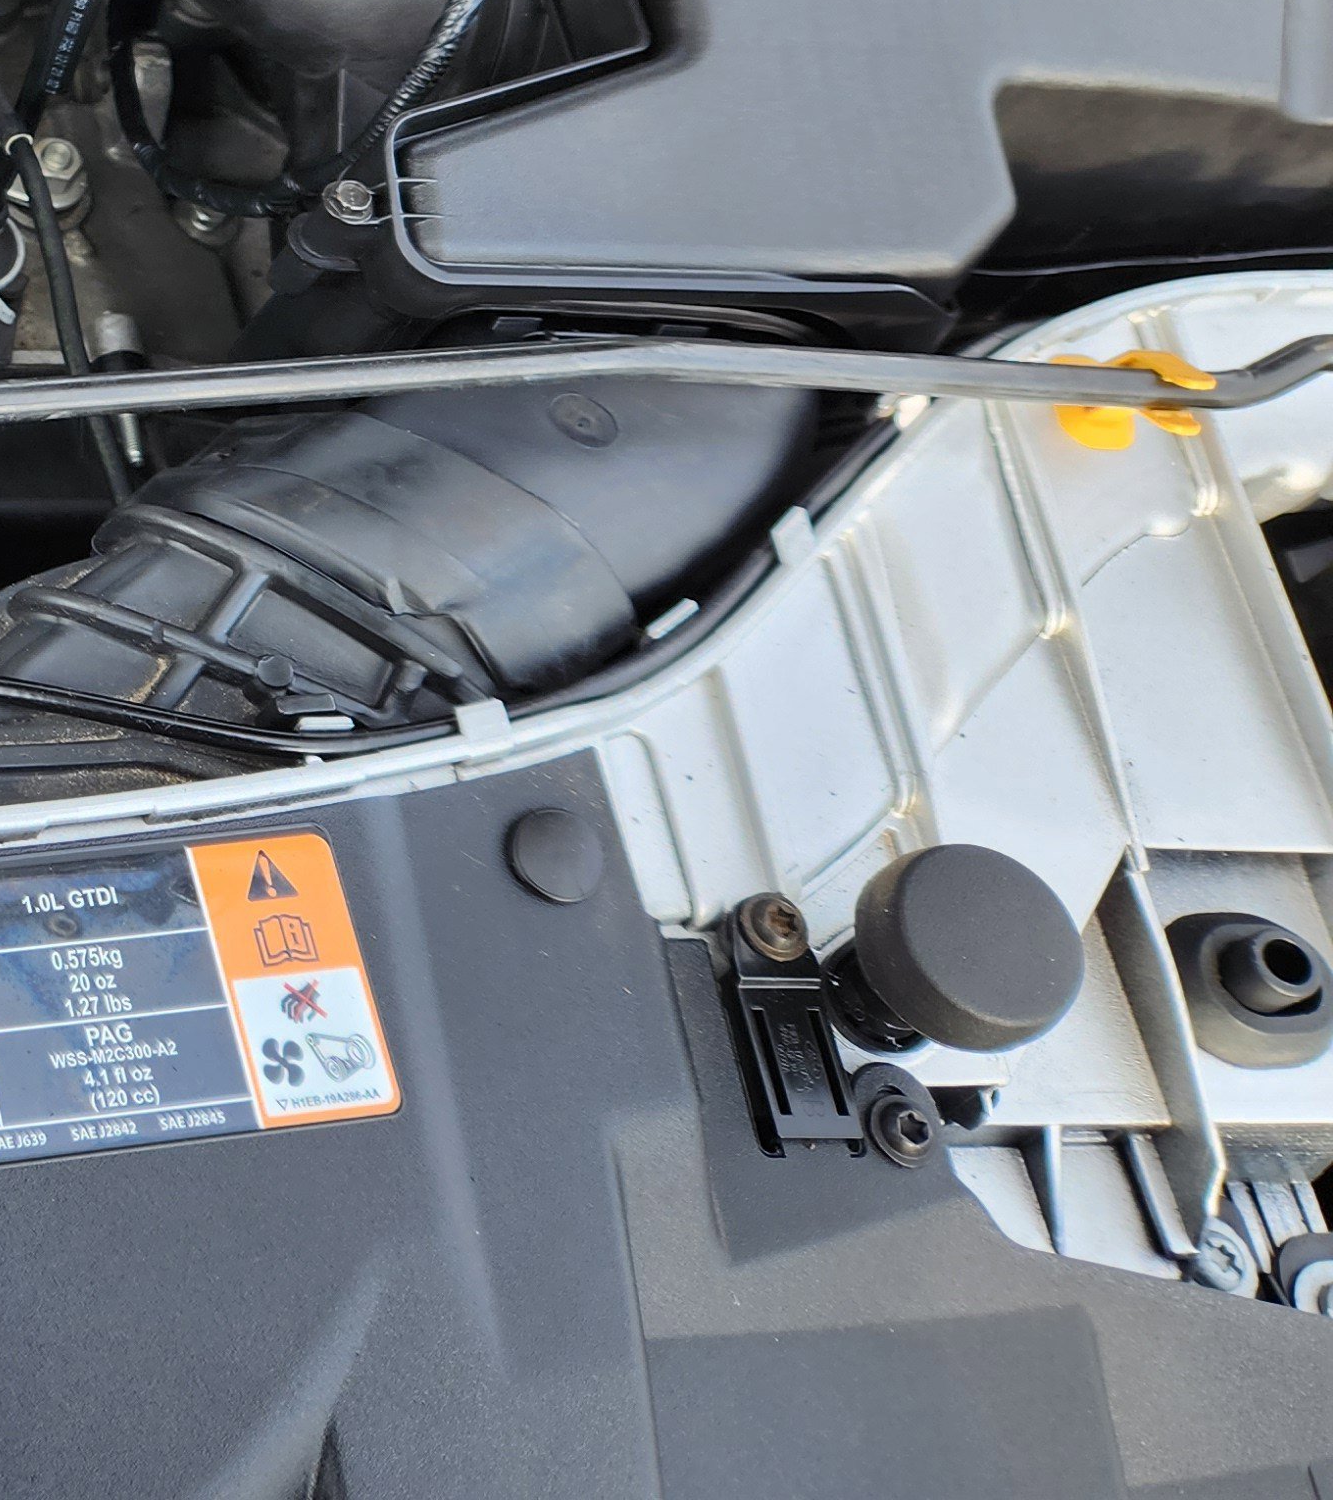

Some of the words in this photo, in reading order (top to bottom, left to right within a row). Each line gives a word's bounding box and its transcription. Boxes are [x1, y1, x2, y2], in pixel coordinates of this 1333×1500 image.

[21, 892, 66, 914] 1.0L
[67, 886, 119, 909] GTDI
[51, 945, 124, 971] 0.575kg
[68, 973, 91, 993] 20
[94, 974, 118, 990] oz
[64, 995, 99, 1018] 1.27
[102, 993, 133, 1014] lbs
[84, 1022, 134, 1047] PAG
[48, 1041, 179, 1070] WSS-M2C300-A2
[84, 1069, 110, 1087] 4.1
[114, 1067, 128, 1084] fl
[132, 1067, 154, 1082] oz
[90, 1088, 128, 1113] (120
[132, 1083, 161, 1106] cc)
